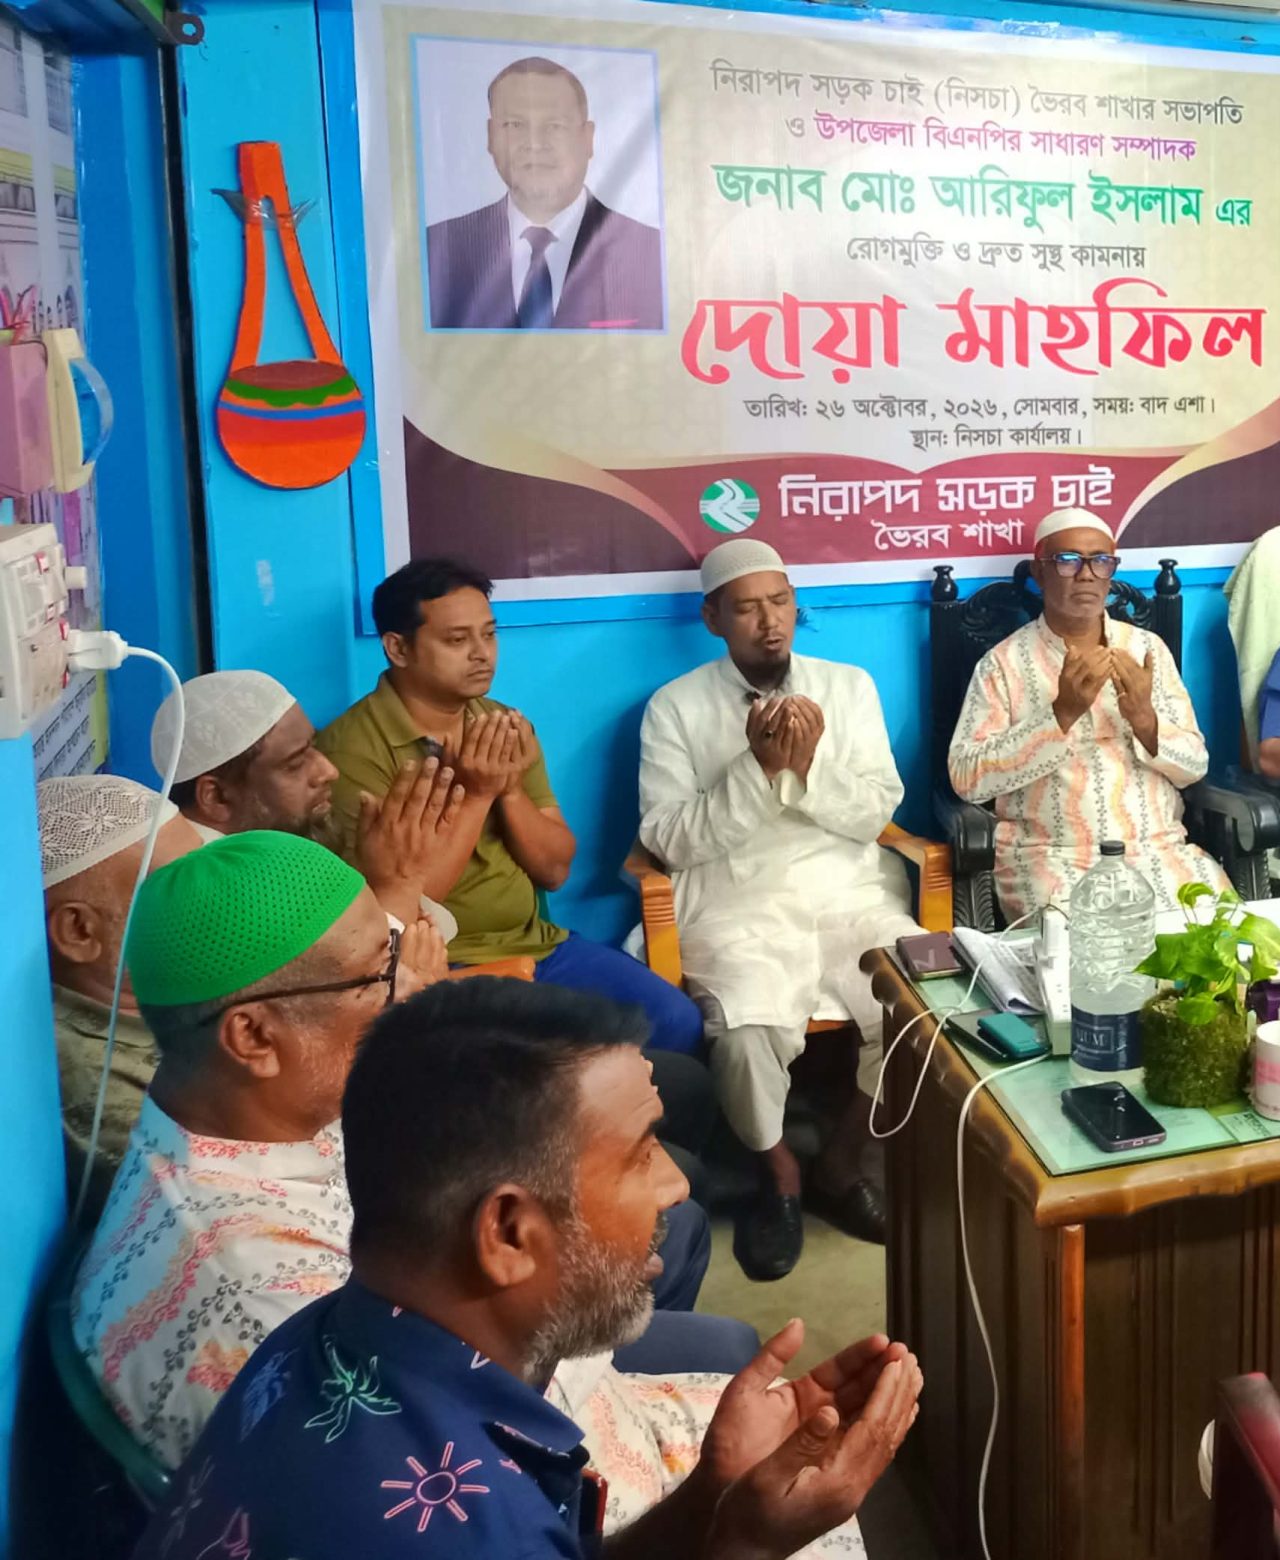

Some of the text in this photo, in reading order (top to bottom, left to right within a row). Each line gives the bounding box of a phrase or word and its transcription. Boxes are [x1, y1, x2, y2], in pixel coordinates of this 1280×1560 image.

[709, 58, 1245, 125] নিরাপদ সড়ক চাই (নিসচা) ভৈরব শাখার সভাপতি
[785, 110, 1197, 161] ও উপজেলা বিএনপির সাধারণ সম্পাদক
[711, 164, 1253, 234] জনাব মোঃ আরিফুল ইসলাম এর
[847, 232, 1147, 272] রোগমুক্তি ও দ্রুত সুস্থ কামনায়
[680, 277, 1267, 385] দোয়া মাহফিল
[743, 393, 808, 419] তারিখ:
[816, 399, 845, 420] ২৬
[1140, 396, 1169, 415] বাদ
[953, 423, 1003, 447] নিসচা
[778, 463, 1116, 521] নিরাপদ সড়ক চাই
[870, 518, 1025, 550] ভৈরব শাখা
